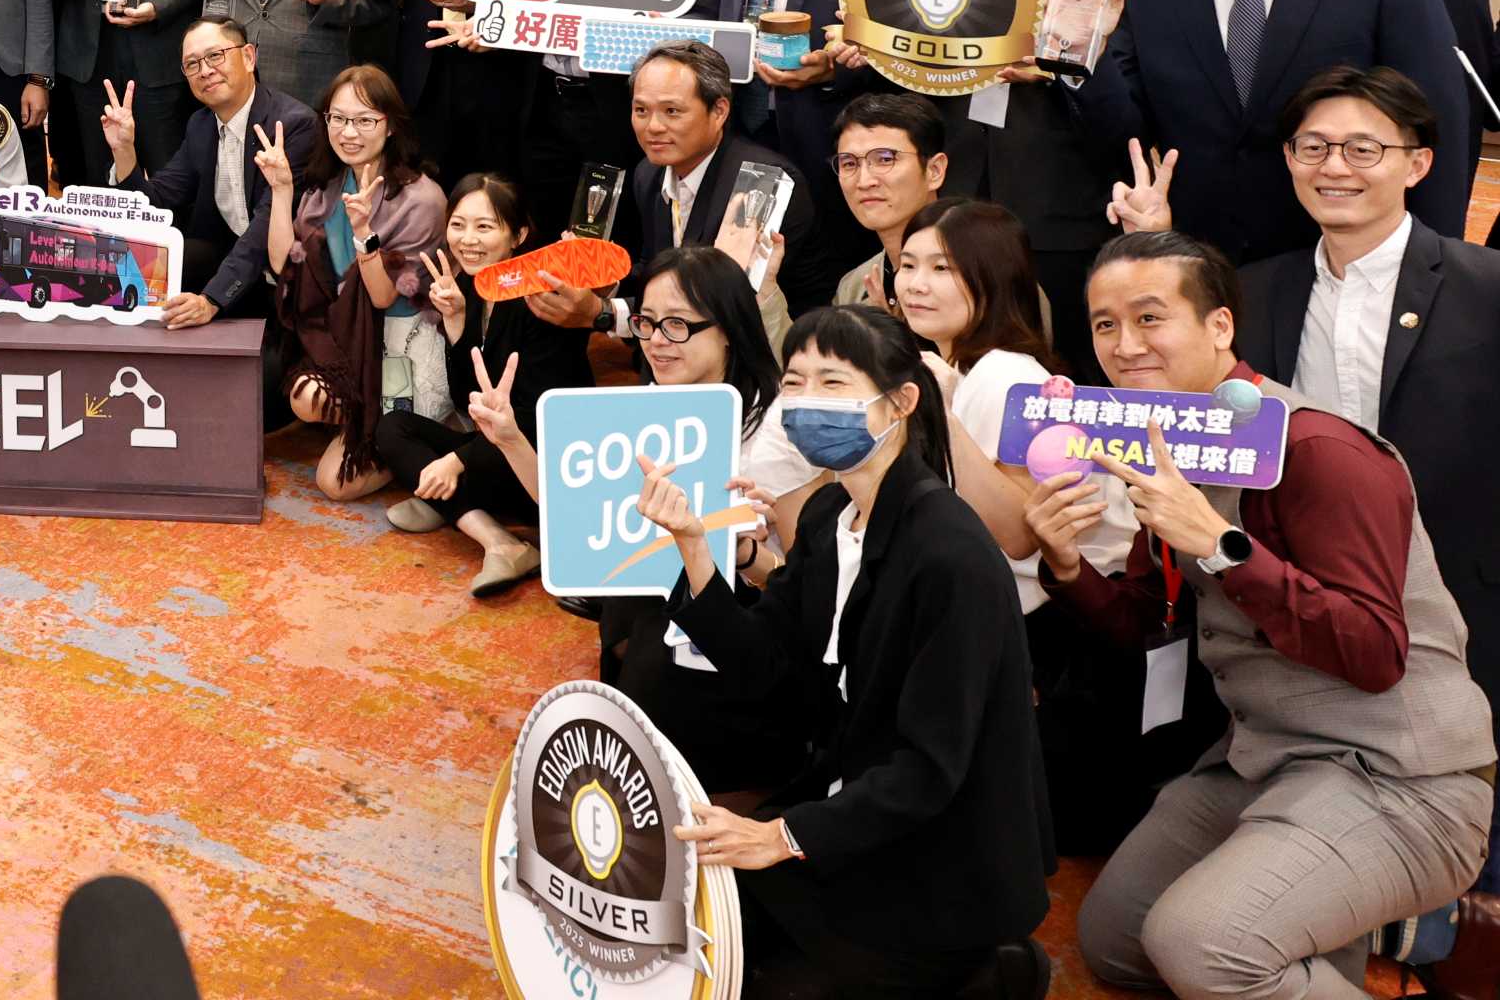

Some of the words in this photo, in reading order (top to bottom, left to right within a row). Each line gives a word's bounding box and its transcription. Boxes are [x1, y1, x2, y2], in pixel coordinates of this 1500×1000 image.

[892, 34, 983, 61] GOLD
[891, 59, 918, 78] 2025
[925, 68, 978, 84] WINNER
[25, 191, 40, 212] 3
[43, 202, 123, 220] Autonomous
[126, 209, 166, 223] E-Bus
[66, 191, 143, 211] 自駕電動巴士
[1022, 395, 1235, 436] 放電精準到外太空
[560, 416, 707, 489] GOOD
[588, 481, 705, 552] JO!
[537, 725, 592, 802] EDISON
[592, 728, 659, 830] AWARDS
[548, 873, 651, 935] SILVER
[559, 917, 585, 949] 2025
[588, 942, 637, 965] WINNER
